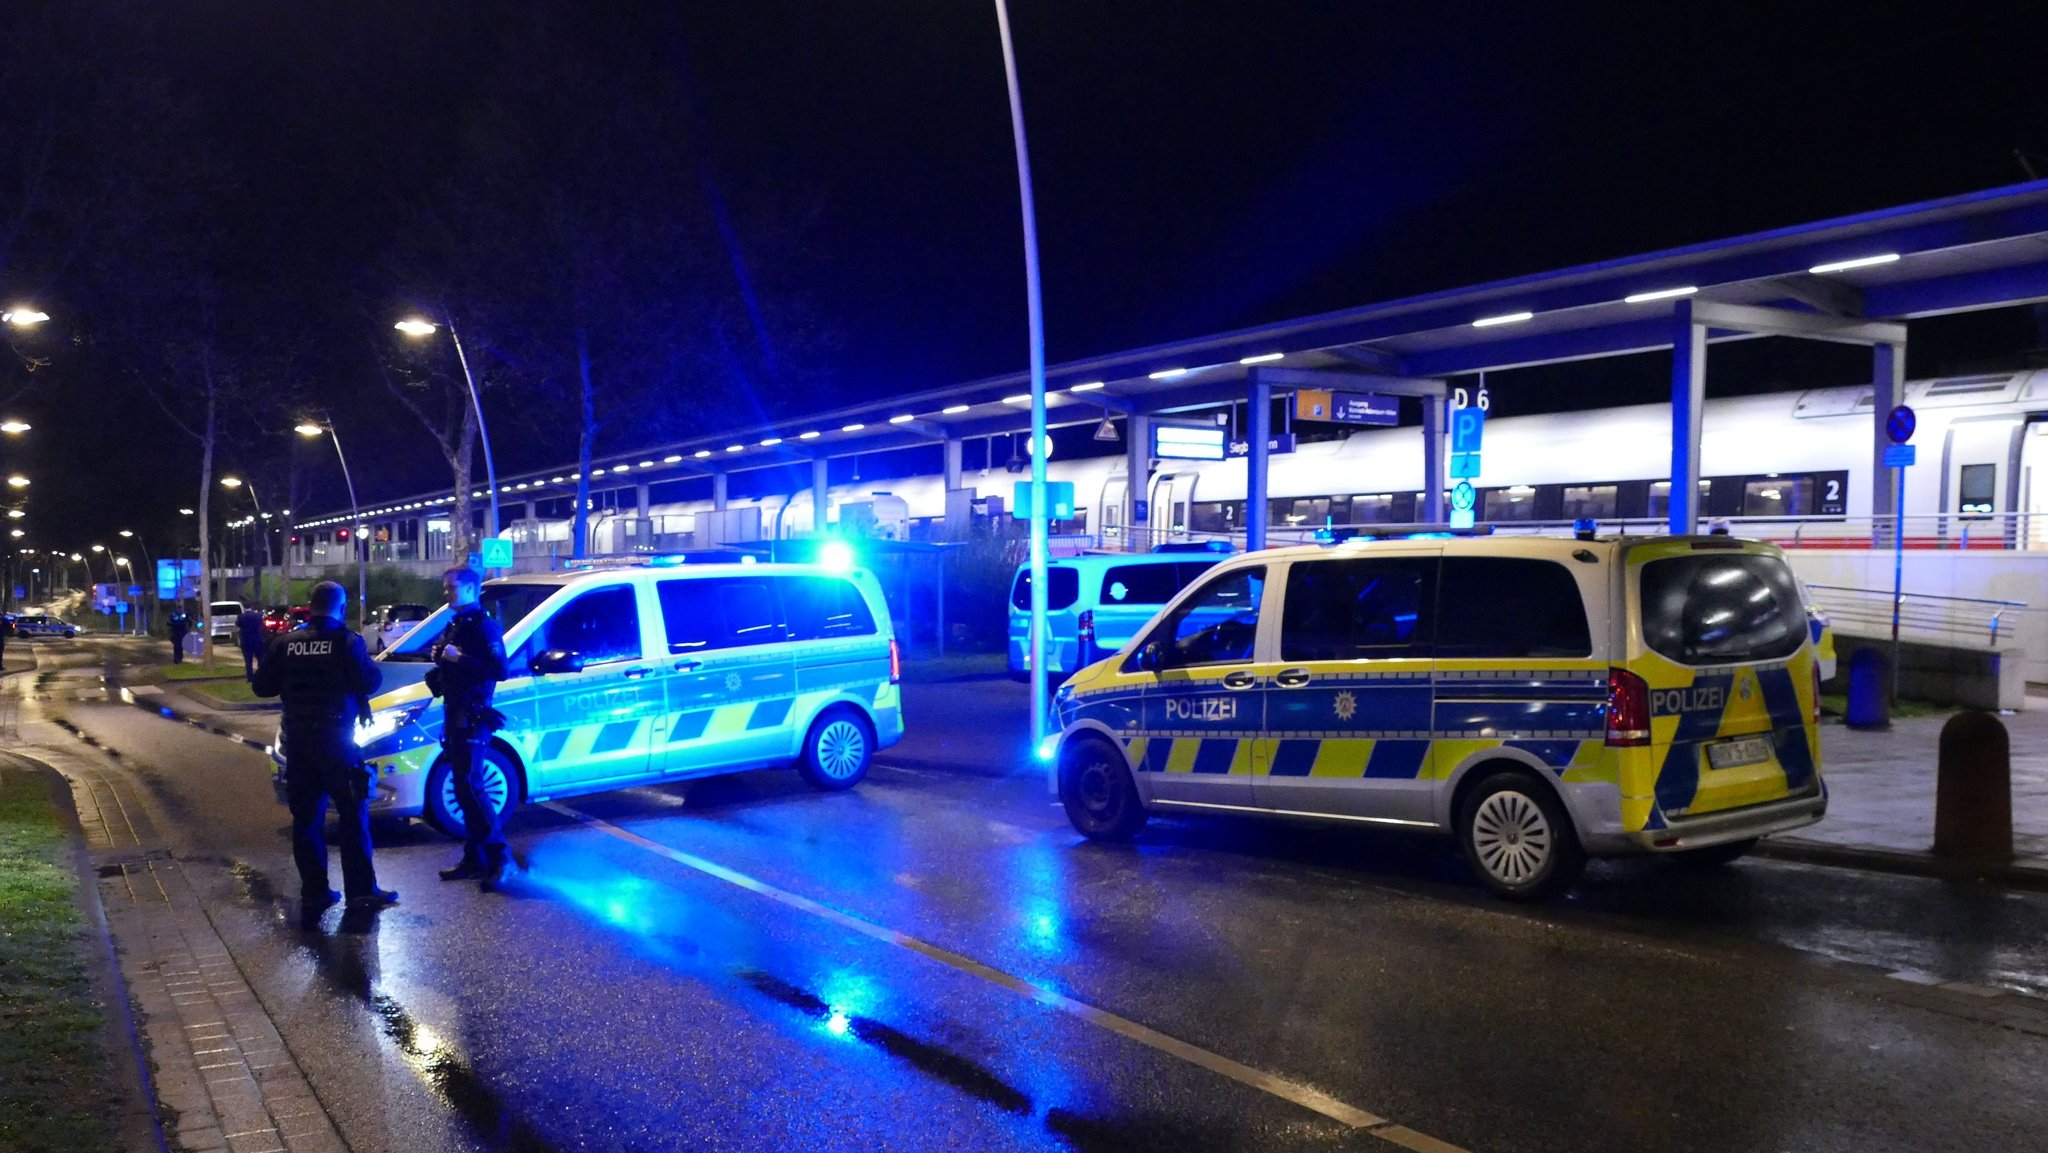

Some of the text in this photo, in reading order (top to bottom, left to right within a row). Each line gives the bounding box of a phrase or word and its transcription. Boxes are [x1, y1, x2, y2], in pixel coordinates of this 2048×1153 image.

[1454, 388, 1490, 411] D 6
[1458, 414, 1476, 448] P
[1825, 480, 1840, 501] 2
[1226, 505, 1234, 520] 2
[287, 640, 333, 656] POLIZEI
[563, 689, 640, 713] POLIZEI
[1165, 697, 1237, 721] POLIZEI
[1652, 686, 1724, 714] POLIZEI
